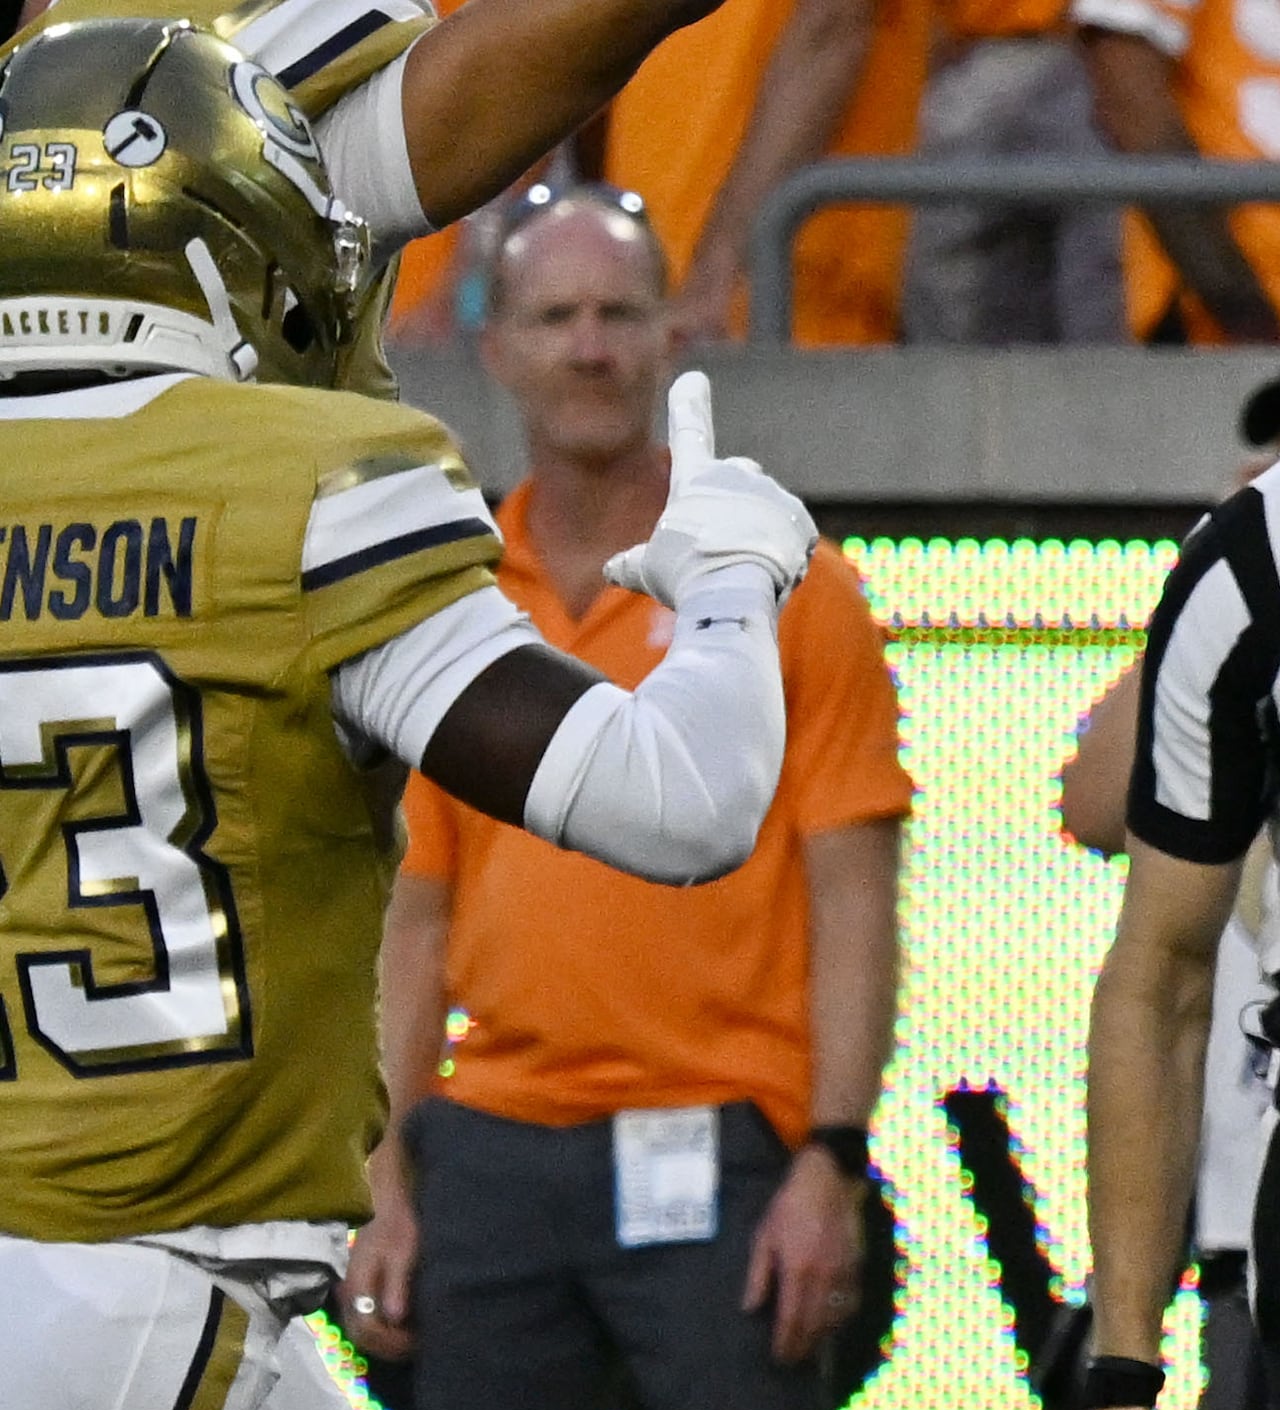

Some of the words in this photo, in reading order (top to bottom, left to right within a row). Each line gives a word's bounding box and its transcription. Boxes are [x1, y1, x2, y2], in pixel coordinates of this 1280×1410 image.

[6, 142, 78, 192] 23
[0, 516, 198, 622] NSON
[0, 650, 254, 1079] 3
